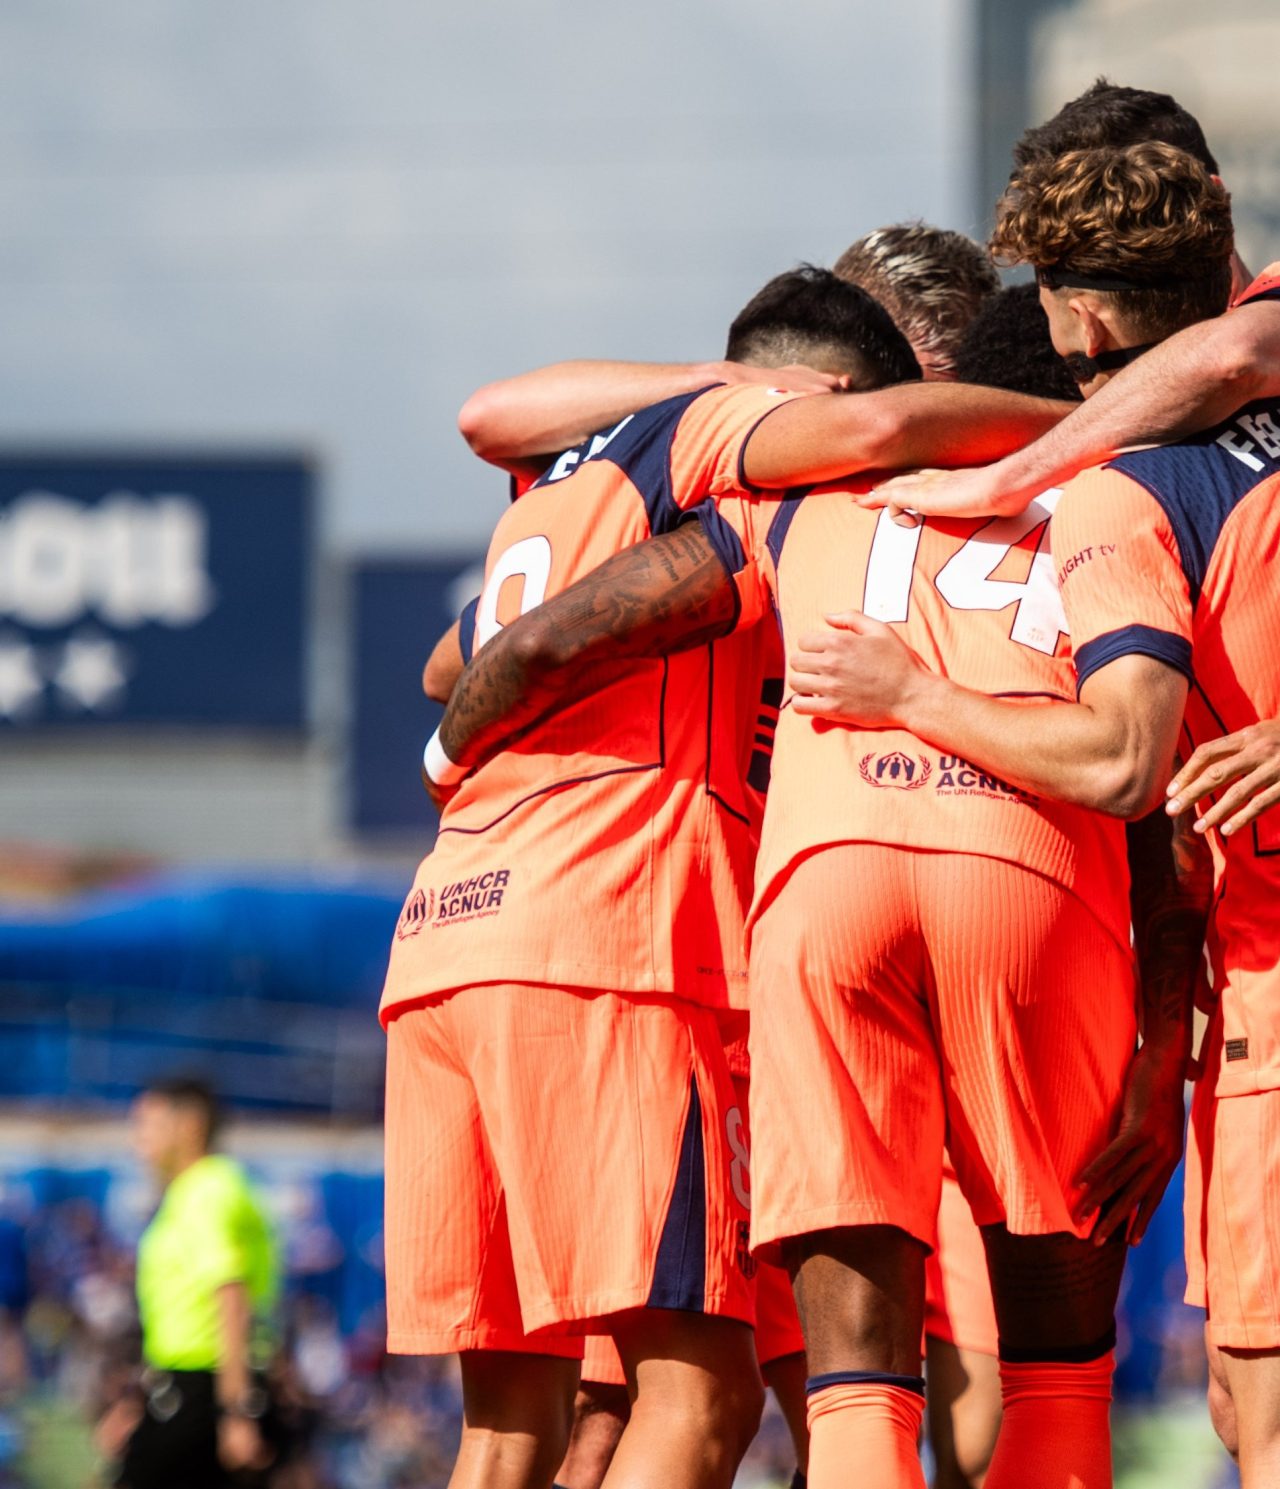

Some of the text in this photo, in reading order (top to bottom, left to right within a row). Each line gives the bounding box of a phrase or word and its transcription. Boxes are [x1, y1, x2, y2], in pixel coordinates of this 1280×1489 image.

[863, 487, 1071, 658] 14
[439, 869, 511, 902] UNHCR
[438, 889, 504, 920] ACNUR
